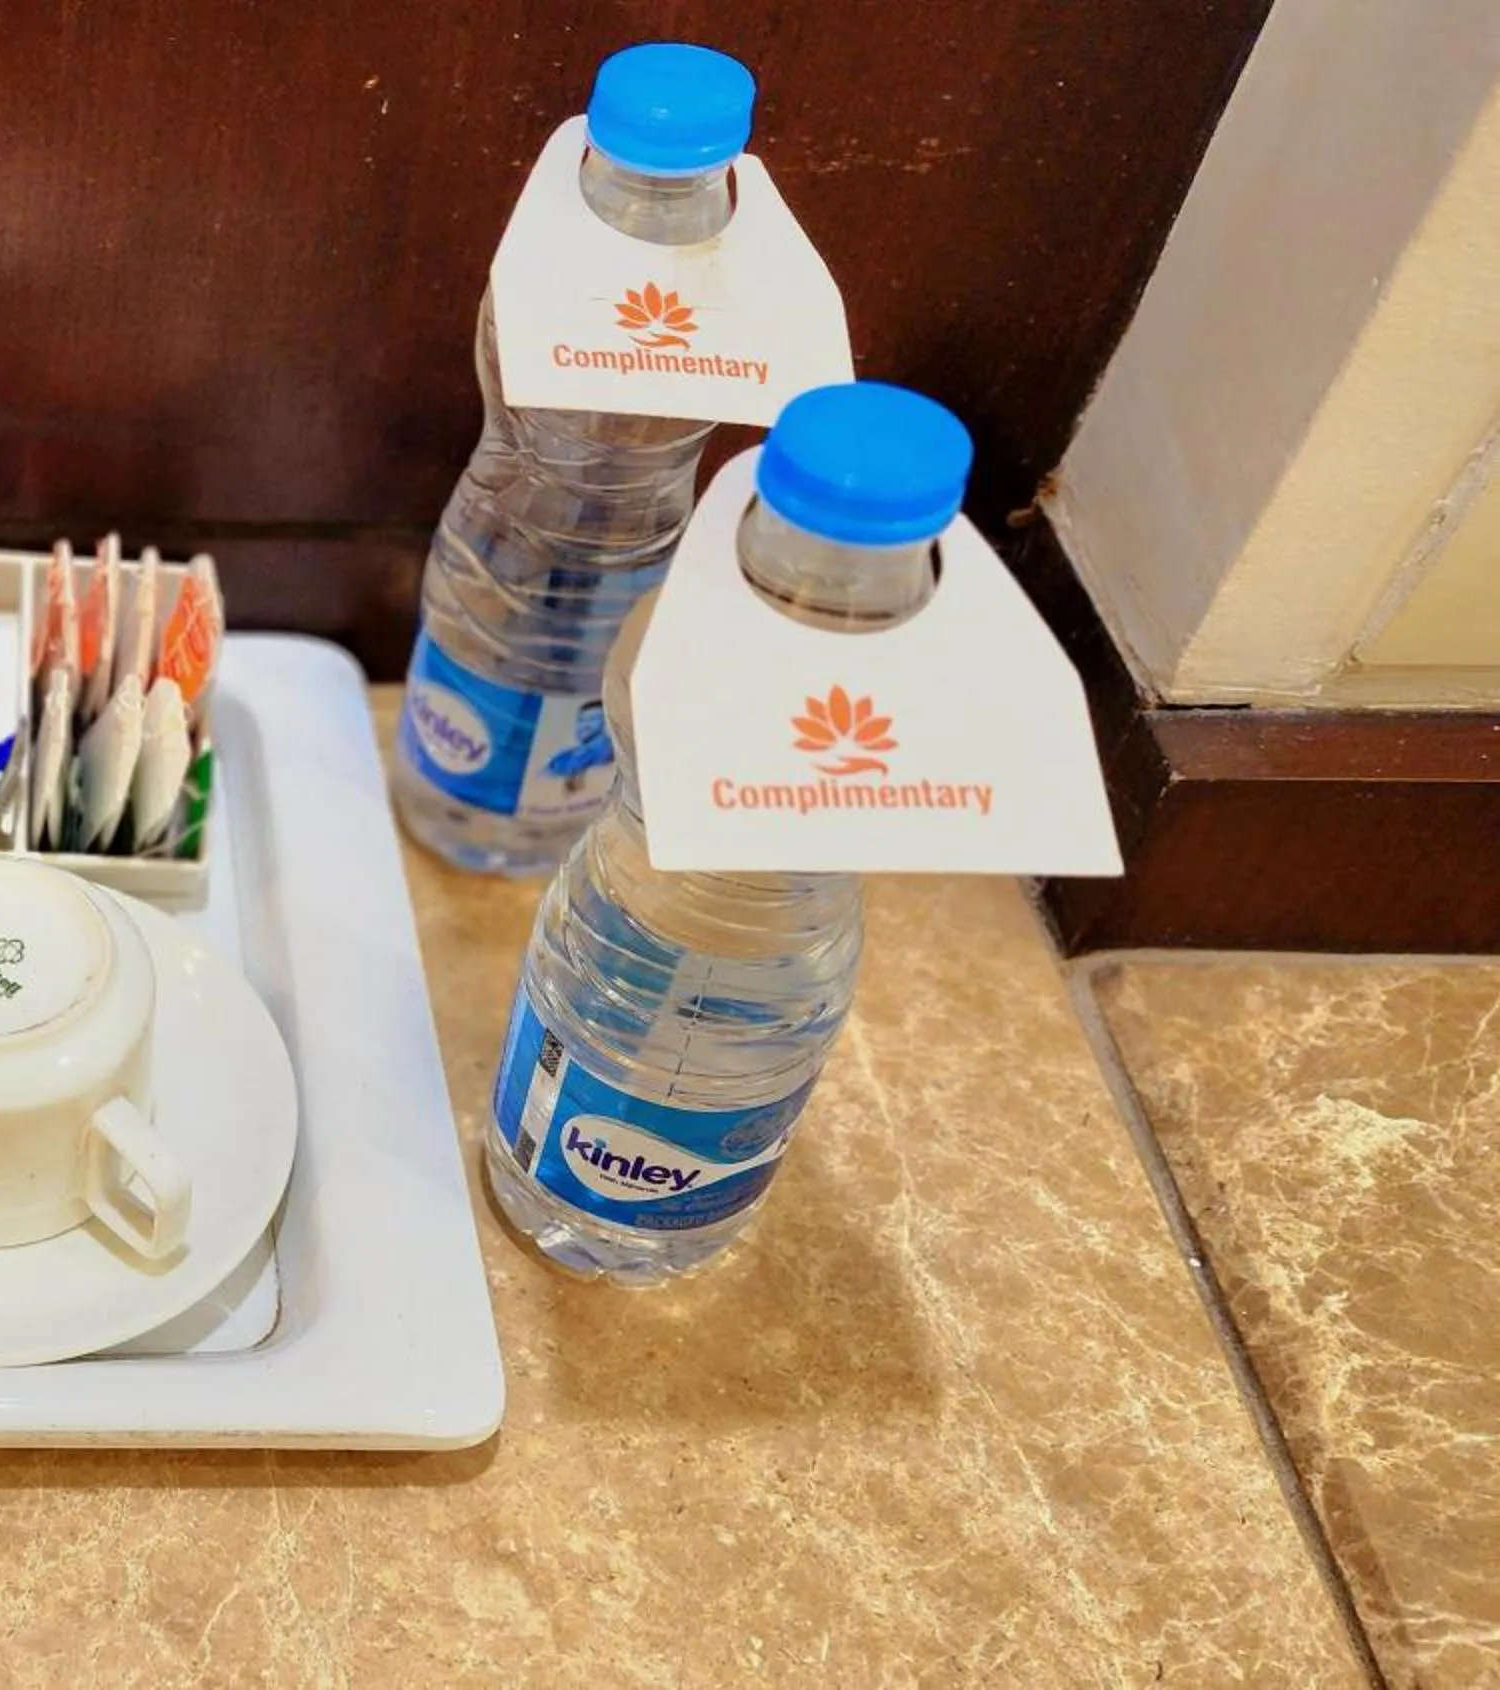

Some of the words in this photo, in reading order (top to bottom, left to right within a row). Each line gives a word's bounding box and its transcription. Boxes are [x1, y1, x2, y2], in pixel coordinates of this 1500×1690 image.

[552, 343, 769, 385] Complimentary
[710, 776, 994, 816] Complimentary
[564, 1126, 701, 1192] kinley
